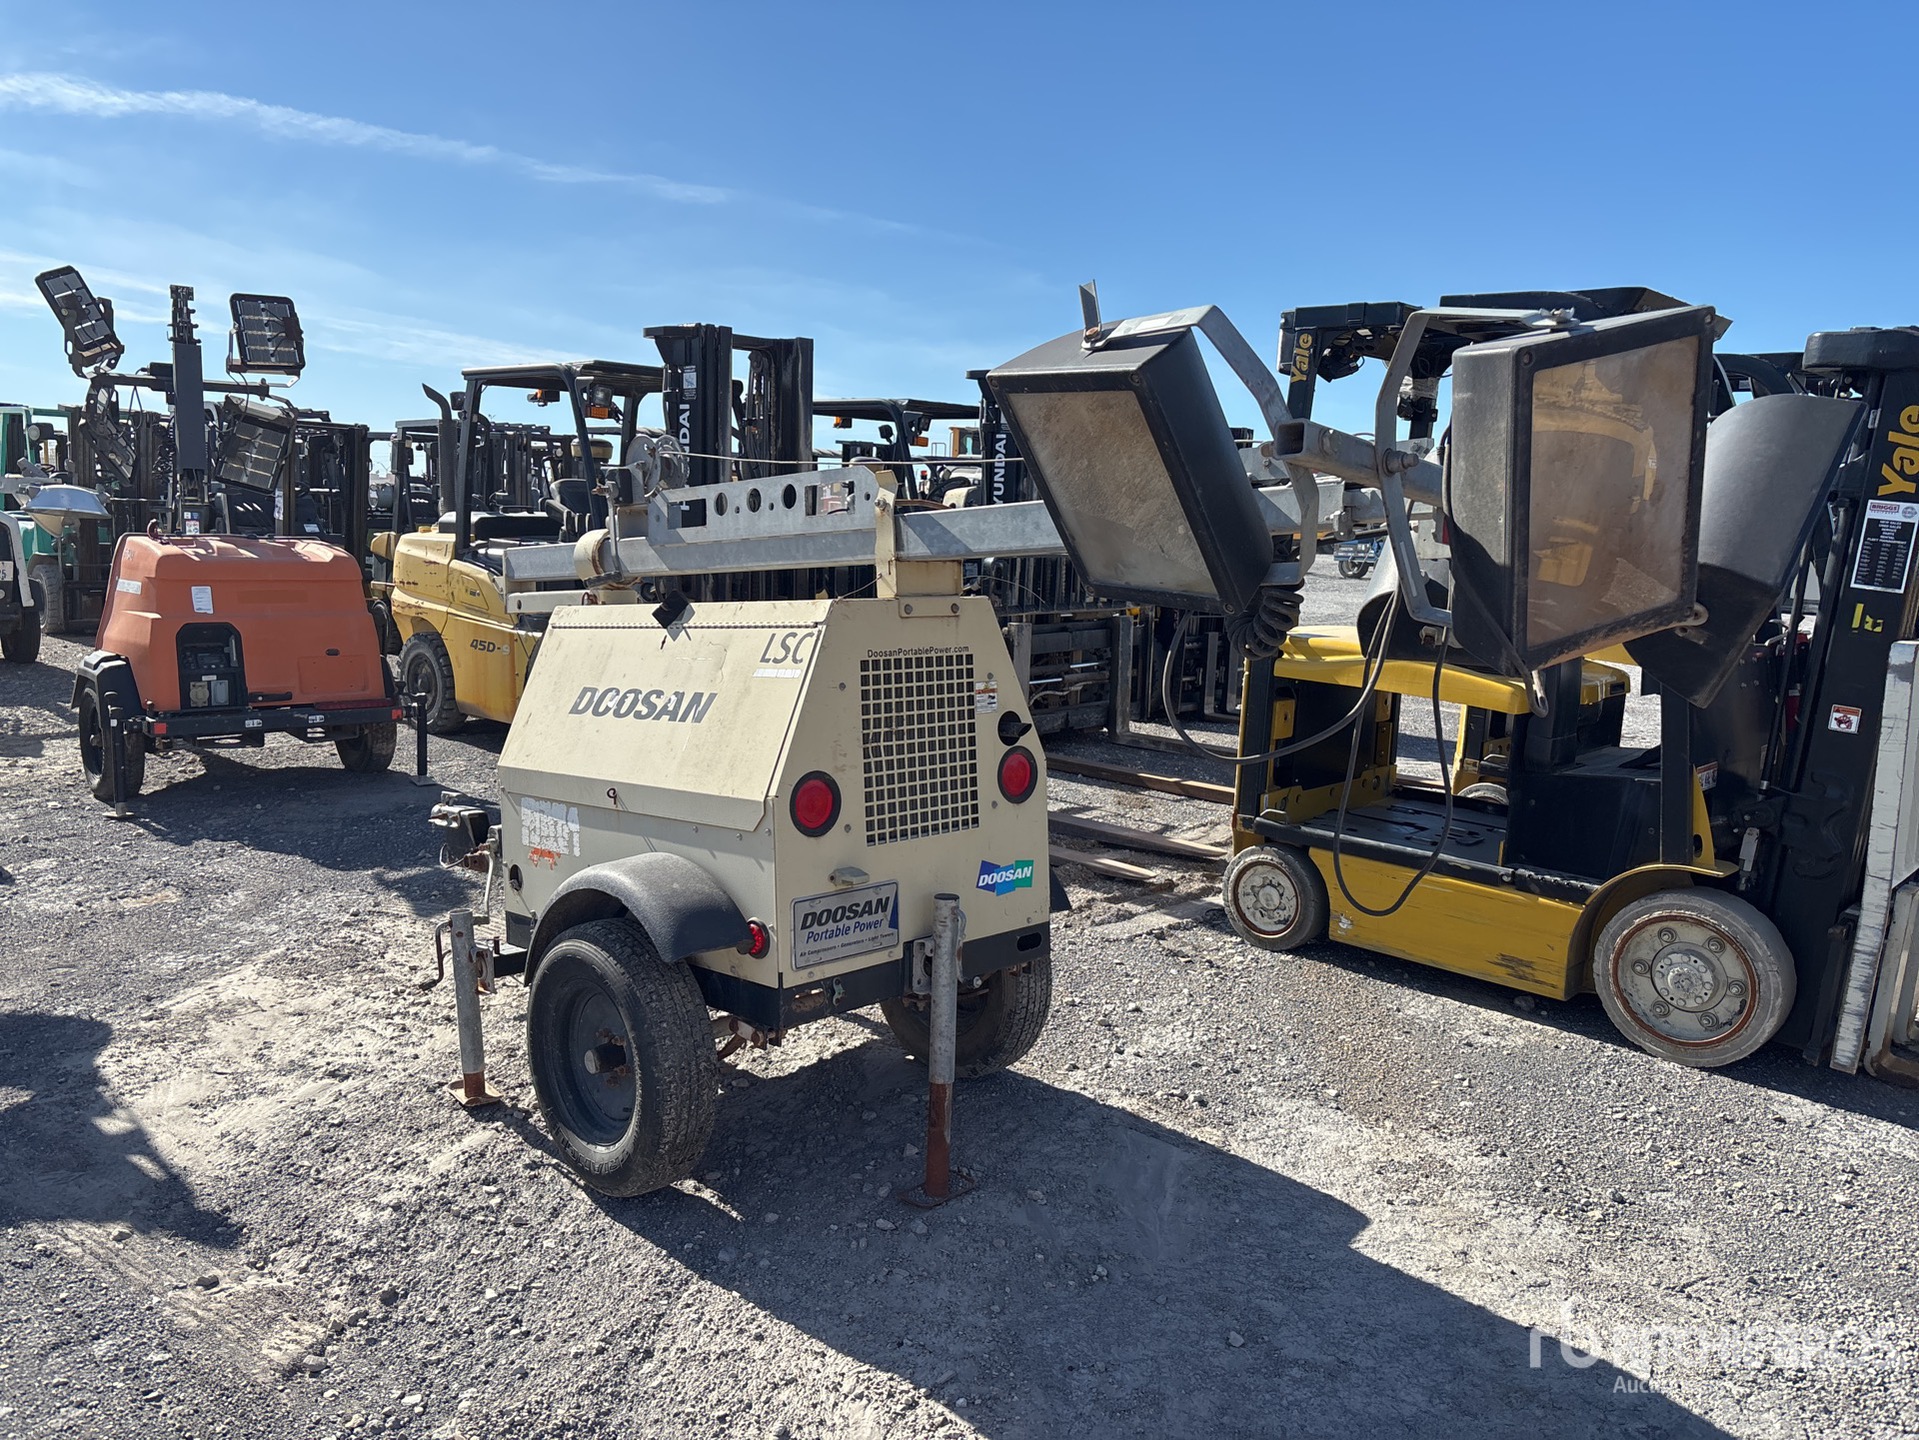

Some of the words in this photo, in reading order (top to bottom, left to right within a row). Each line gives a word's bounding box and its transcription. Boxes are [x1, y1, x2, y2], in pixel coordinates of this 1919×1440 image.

[1291, 333, 1313, 383] Yale
[1877, 405, 1919, 496] Yale
[867, 645, 970, 658] DoosanPortablePower.com
[978, 865, 1032, 887] DOOSAN
[800, 896, 890, 930] DOOSAN
[805, 923, 851, 945] Portable
[852, 918, 884, 934] Power
